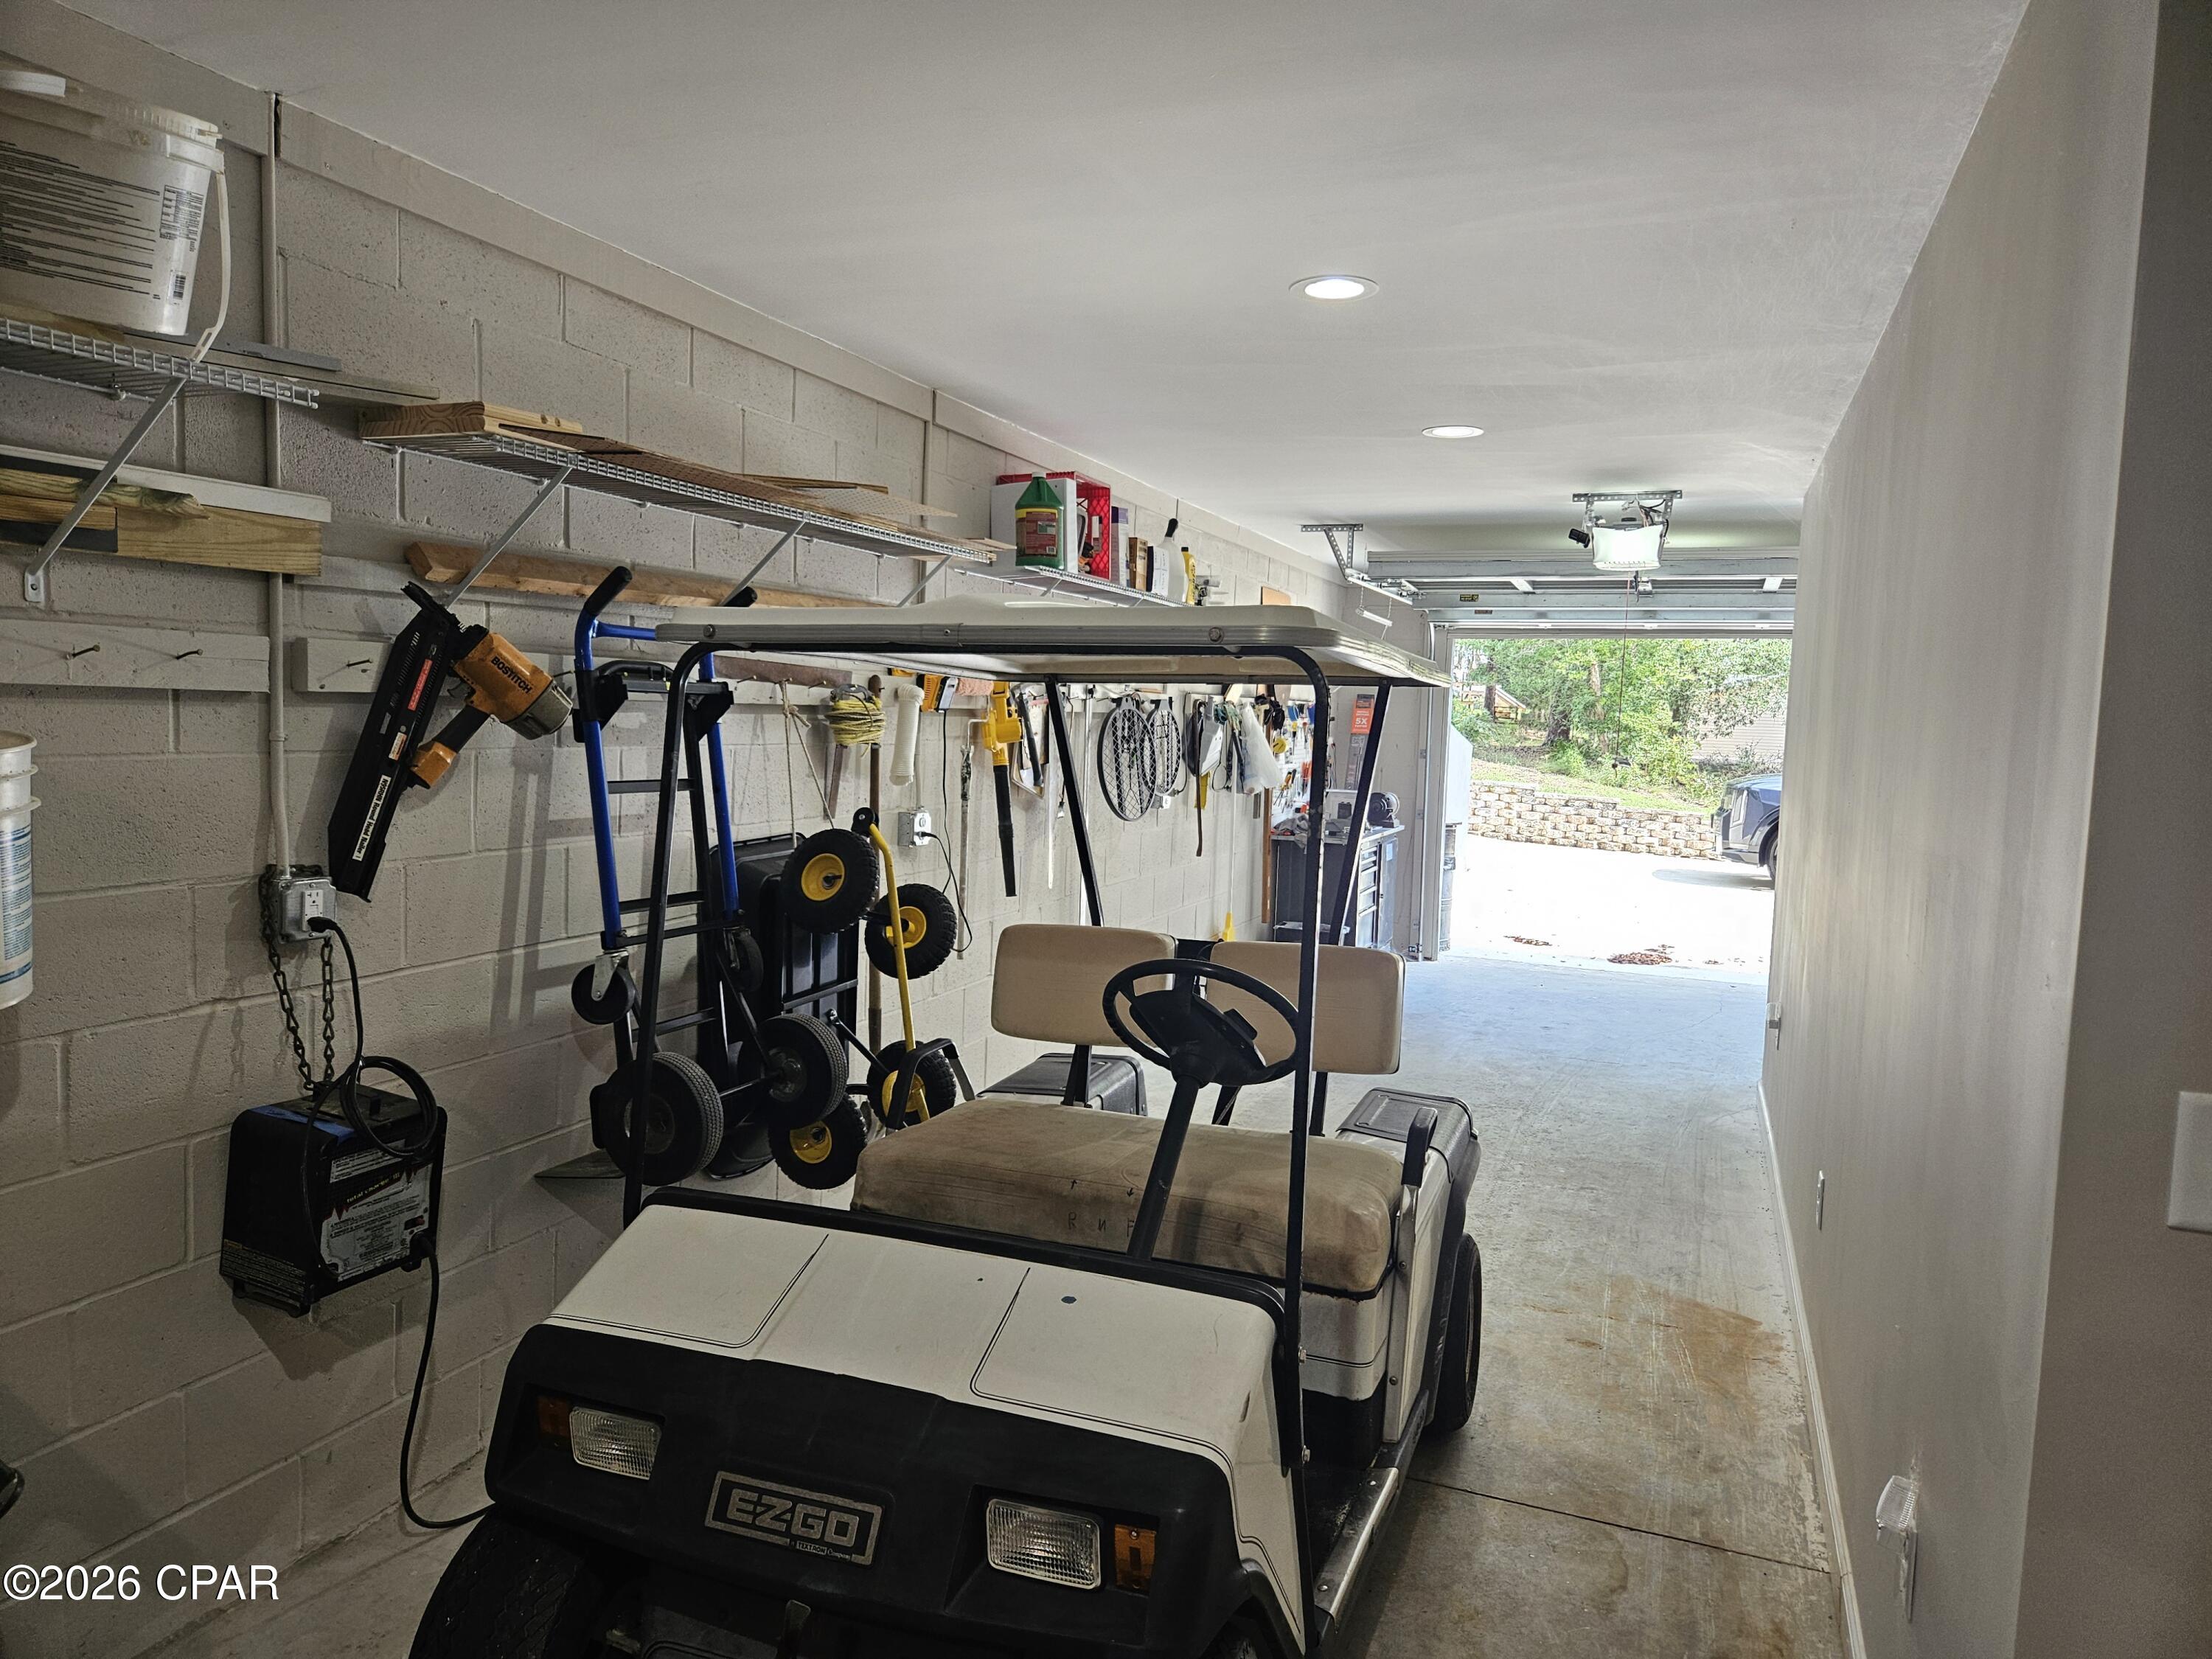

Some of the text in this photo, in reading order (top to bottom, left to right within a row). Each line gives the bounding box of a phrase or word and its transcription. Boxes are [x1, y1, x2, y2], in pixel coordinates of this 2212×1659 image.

[491, 656, 532, 694] BOSTITCH
[369, 802, 380, 821] Round
[363, 821, 373, 836] Head
[357, 836, 367, 854] Nailer
[347, 1192, 364, 1203] total
[1068, 1211, 1077, 1230] R
[1127, 1217, 1135, 1237] F
[726, 1488, 859, 1547] EZGO
[798, 1542, 826, 1555] TEXTRON
